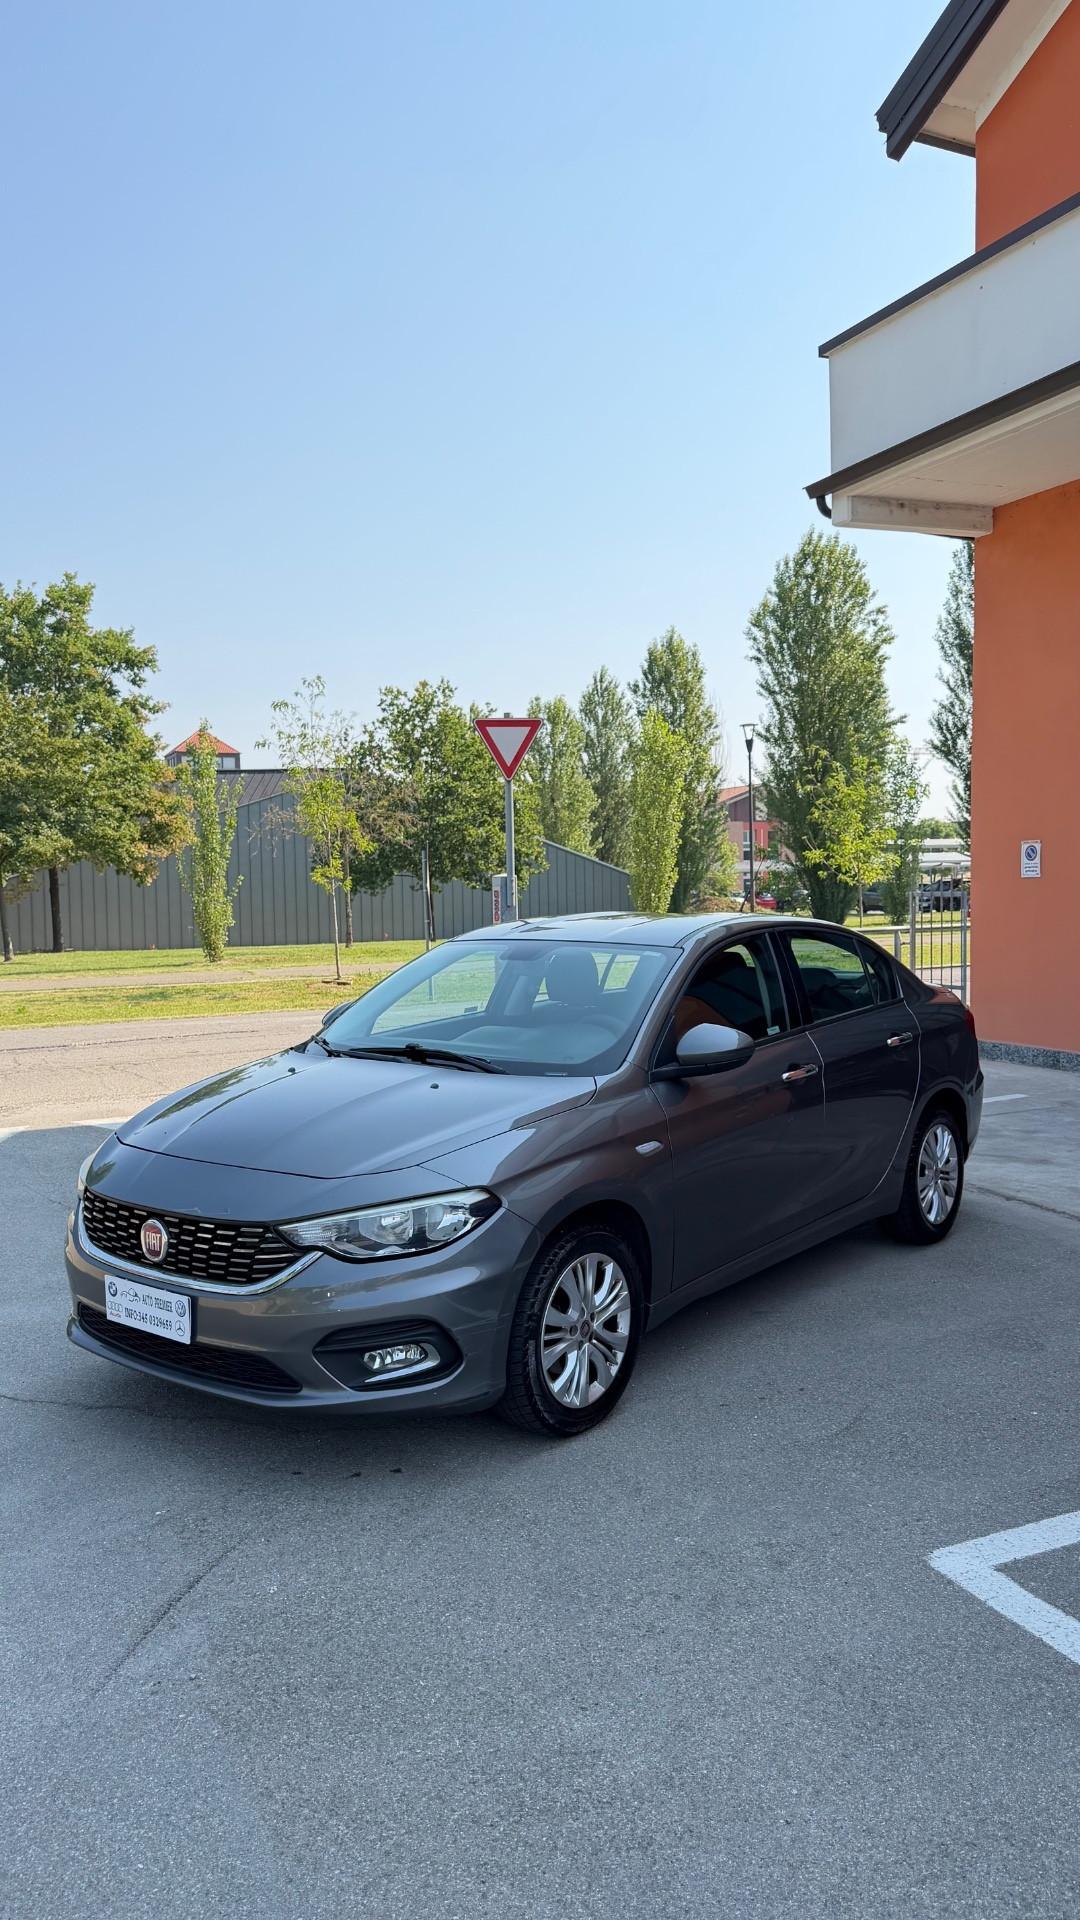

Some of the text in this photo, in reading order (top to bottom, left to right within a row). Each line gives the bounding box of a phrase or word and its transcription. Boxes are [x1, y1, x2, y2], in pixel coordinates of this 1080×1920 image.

[146, 1231, 161, 1251] FIAT
[142, 1294, 173, 1312] AUTO PREMIER
